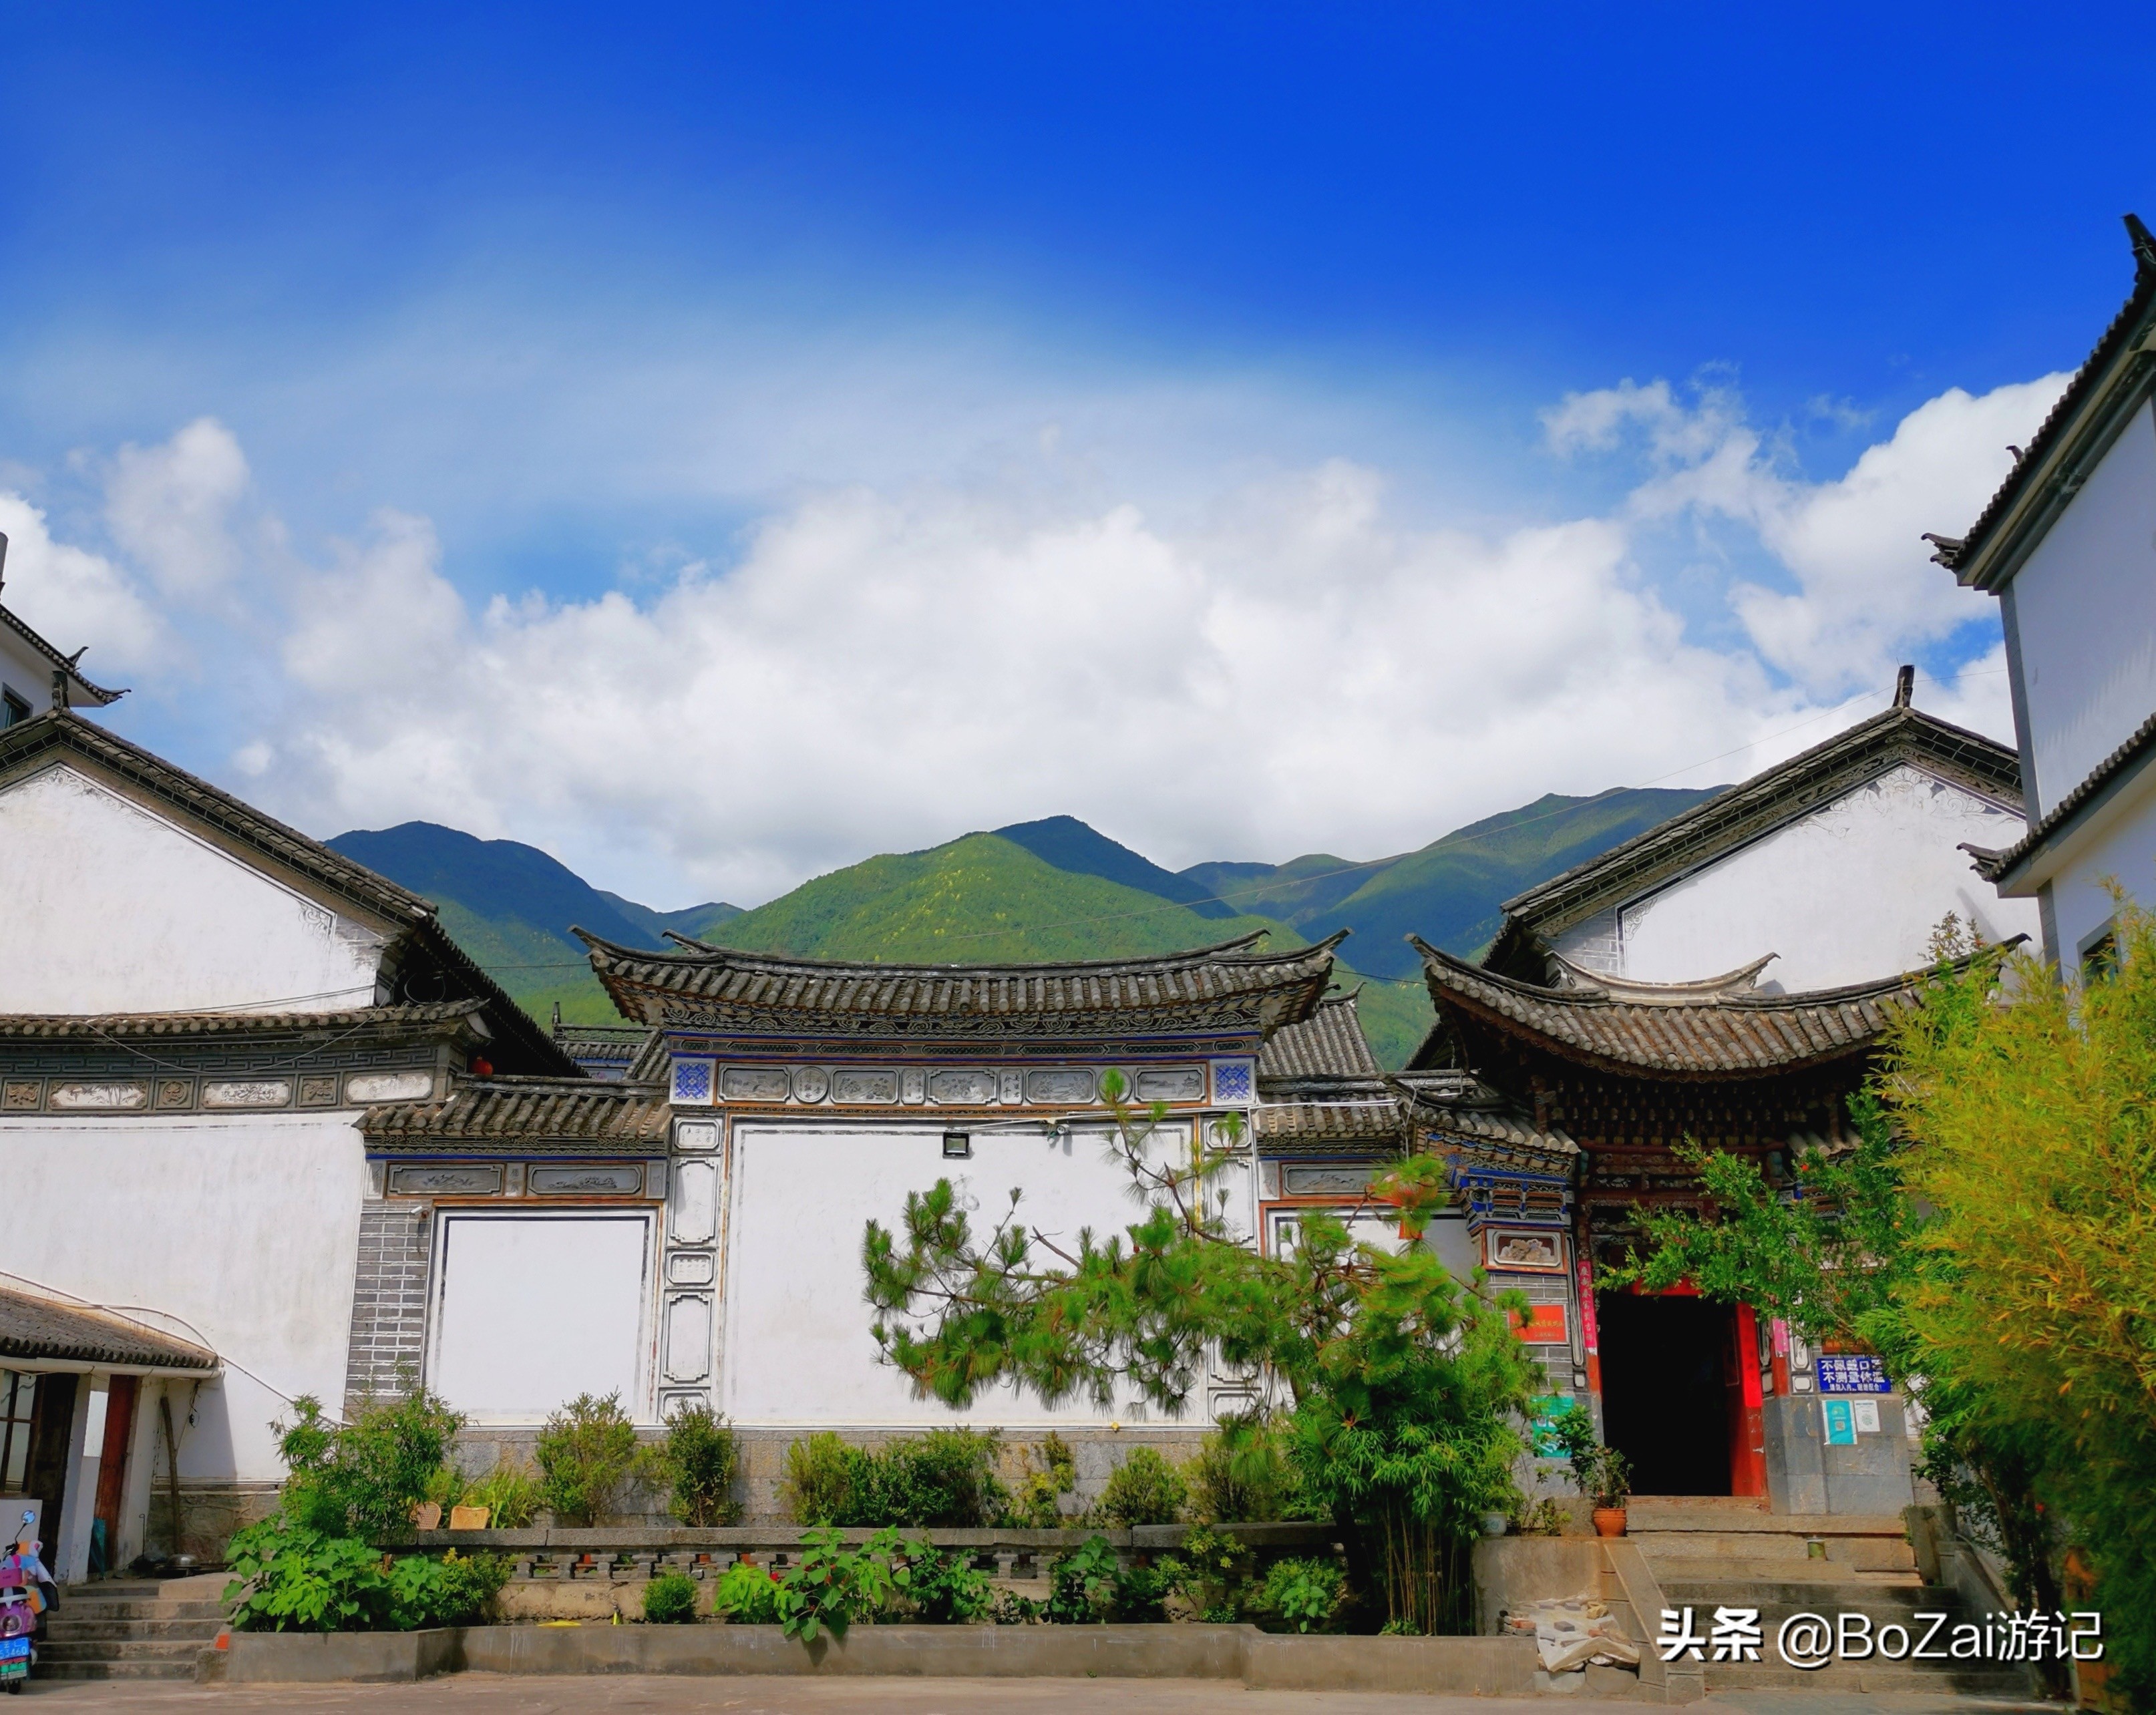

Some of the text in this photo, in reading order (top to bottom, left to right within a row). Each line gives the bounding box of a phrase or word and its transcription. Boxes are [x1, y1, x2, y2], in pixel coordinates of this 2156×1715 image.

[1823, 1371, 1885, 1383] 不测量体温
